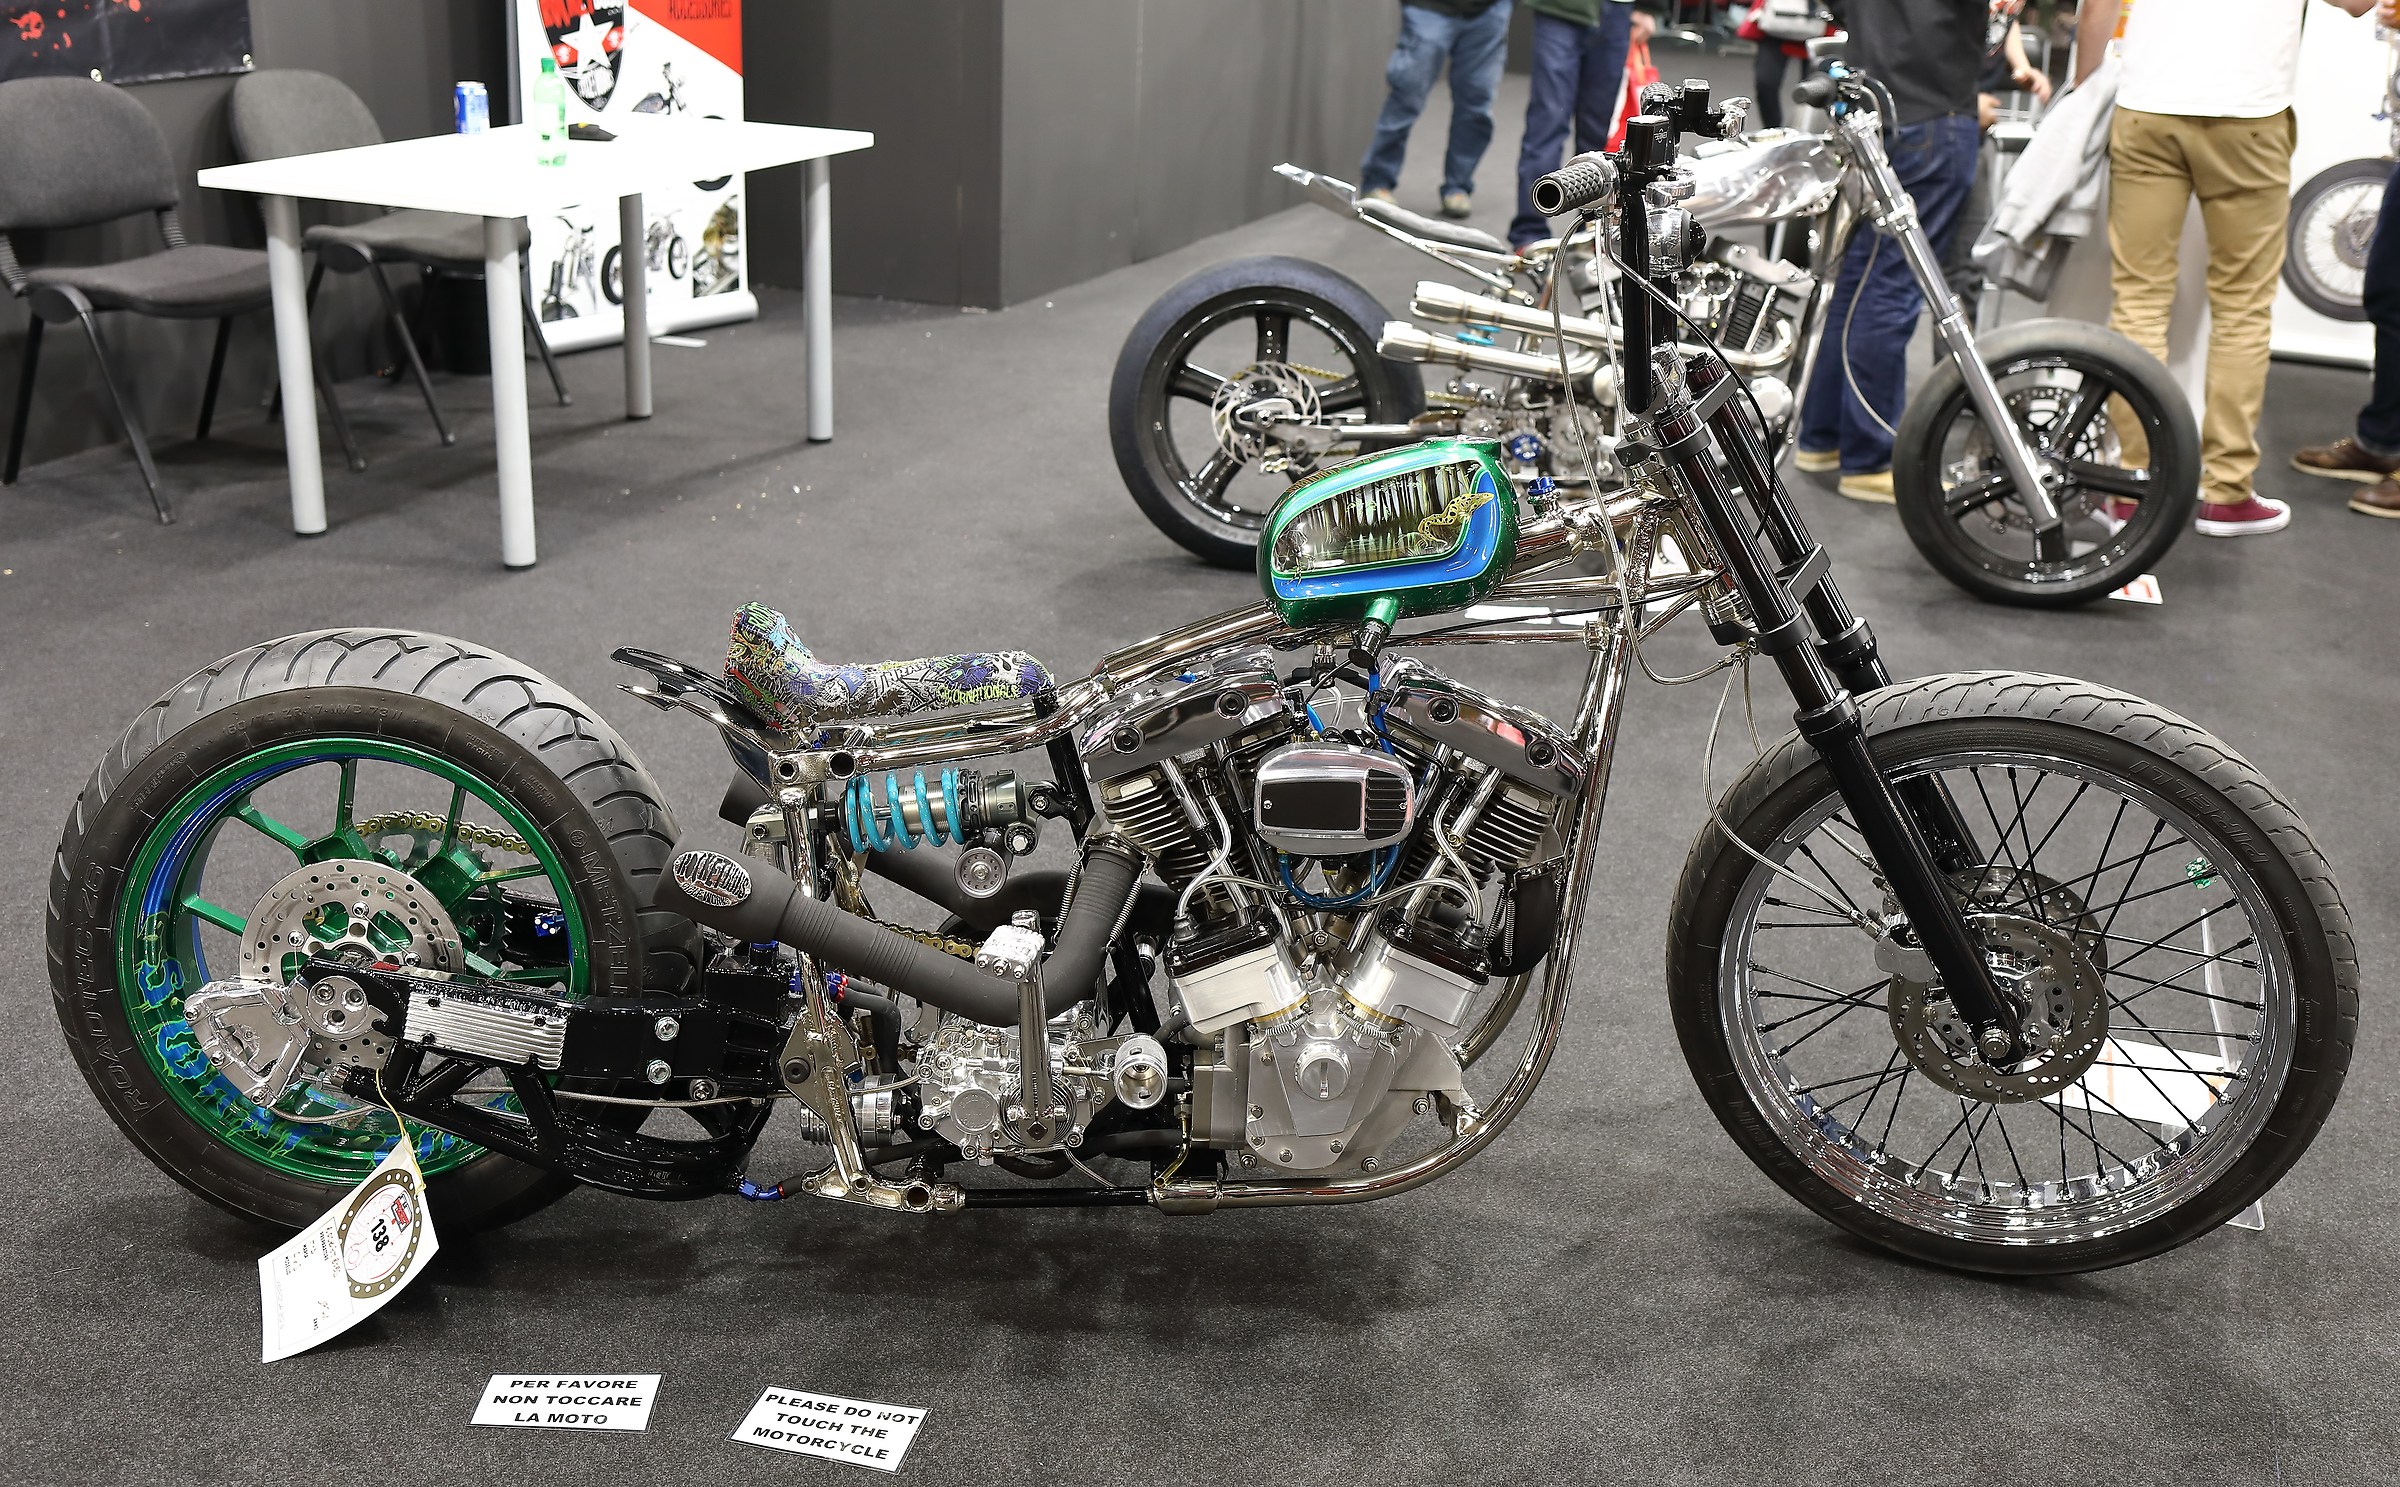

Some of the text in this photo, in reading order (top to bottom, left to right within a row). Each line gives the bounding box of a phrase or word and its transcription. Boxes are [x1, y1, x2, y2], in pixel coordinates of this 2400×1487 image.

[2128, 760, 2269, 864] PIRELLI
[77, 926, 152, 1122] ROADTEC
[370, 1218, 389, 1252] 138
[510, 1380, 639, 1389] PER FAVORE
[493, 1395, 643, 1407] NON TOCCARE
[765, 1394, 920, 1426] PLEASE DO NOT
[514, 1412, 608, 1424] LA MOTO
[776, 1412, 889, 1440] TOUCH THE
[752, 1426, 890, 1460] MOTORCYCLE
